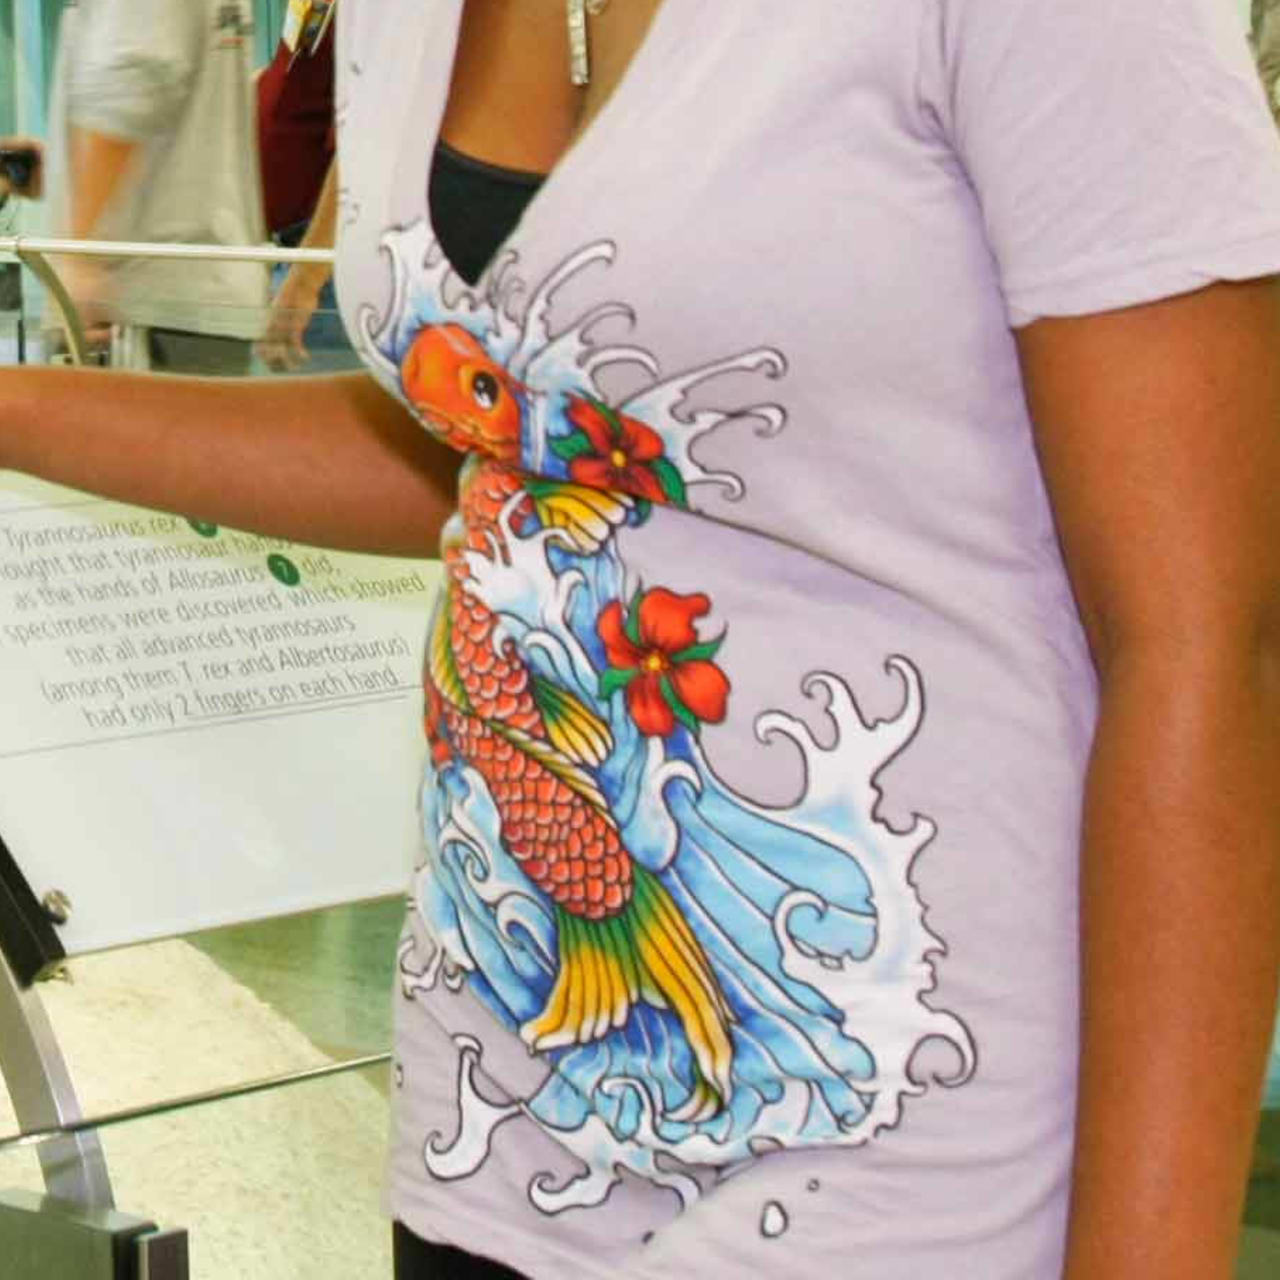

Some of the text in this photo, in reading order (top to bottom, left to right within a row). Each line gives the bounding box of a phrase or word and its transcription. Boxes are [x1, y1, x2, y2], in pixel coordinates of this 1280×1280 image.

[2, 519, 146, 553] Tyrannosaurus
[68, 551, 111, 572] that
[113, 540, 229, 571] tyrannosaur
[4, 613, 117, 646] specimens
[118, 607, 171, 629] were
[290, 581, 347, 608] which
[348, 572, 426, 601] showed
[38, 586, 75, 606] the
[75, 576, 139, 601] hands
[141, 571, 163, 594] of
[168, 566, 265, 591] Allosaurus
[65, 612, 356, 667] that all advanced tyrannosaurs
[41, 673, 125, 705] (among
[122, 667, 177, 691] them
[201, 663, 231, 682] rex
[239, 649, 276, 675] and
[80, 702, 128, 728] had
[130, 698, 176, 726] only
[177, 692, 192, 717] 2
[194, 685, 266, 715] fingers
[268, 685, 296, 703] on
[299, 672, 350, 698] each
